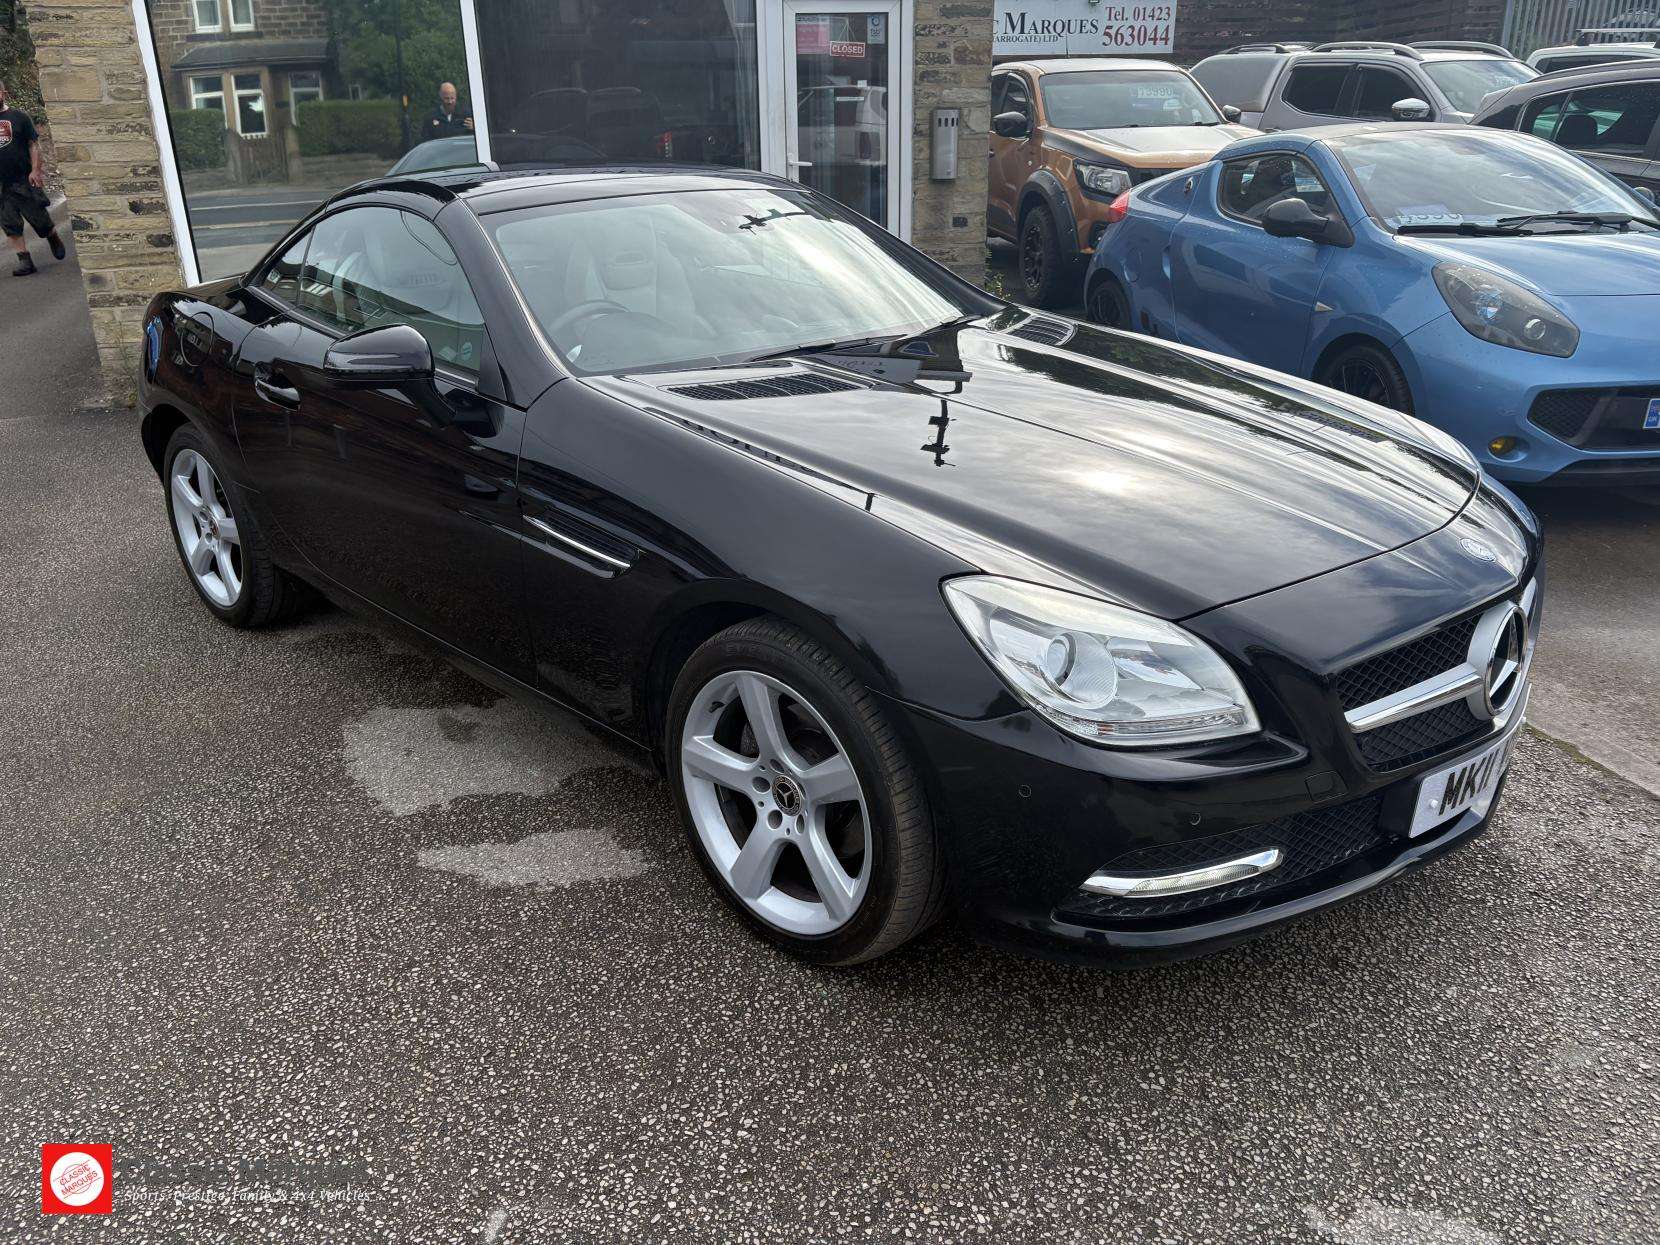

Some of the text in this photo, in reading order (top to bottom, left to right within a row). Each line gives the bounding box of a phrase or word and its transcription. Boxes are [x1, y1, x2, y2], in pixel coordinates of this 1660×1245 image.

[1105, 6, 1171, 21] Tel. 01423
[1102, 24, 1170, 47] 563044
[831, 45, 863, 54] CLOSED
